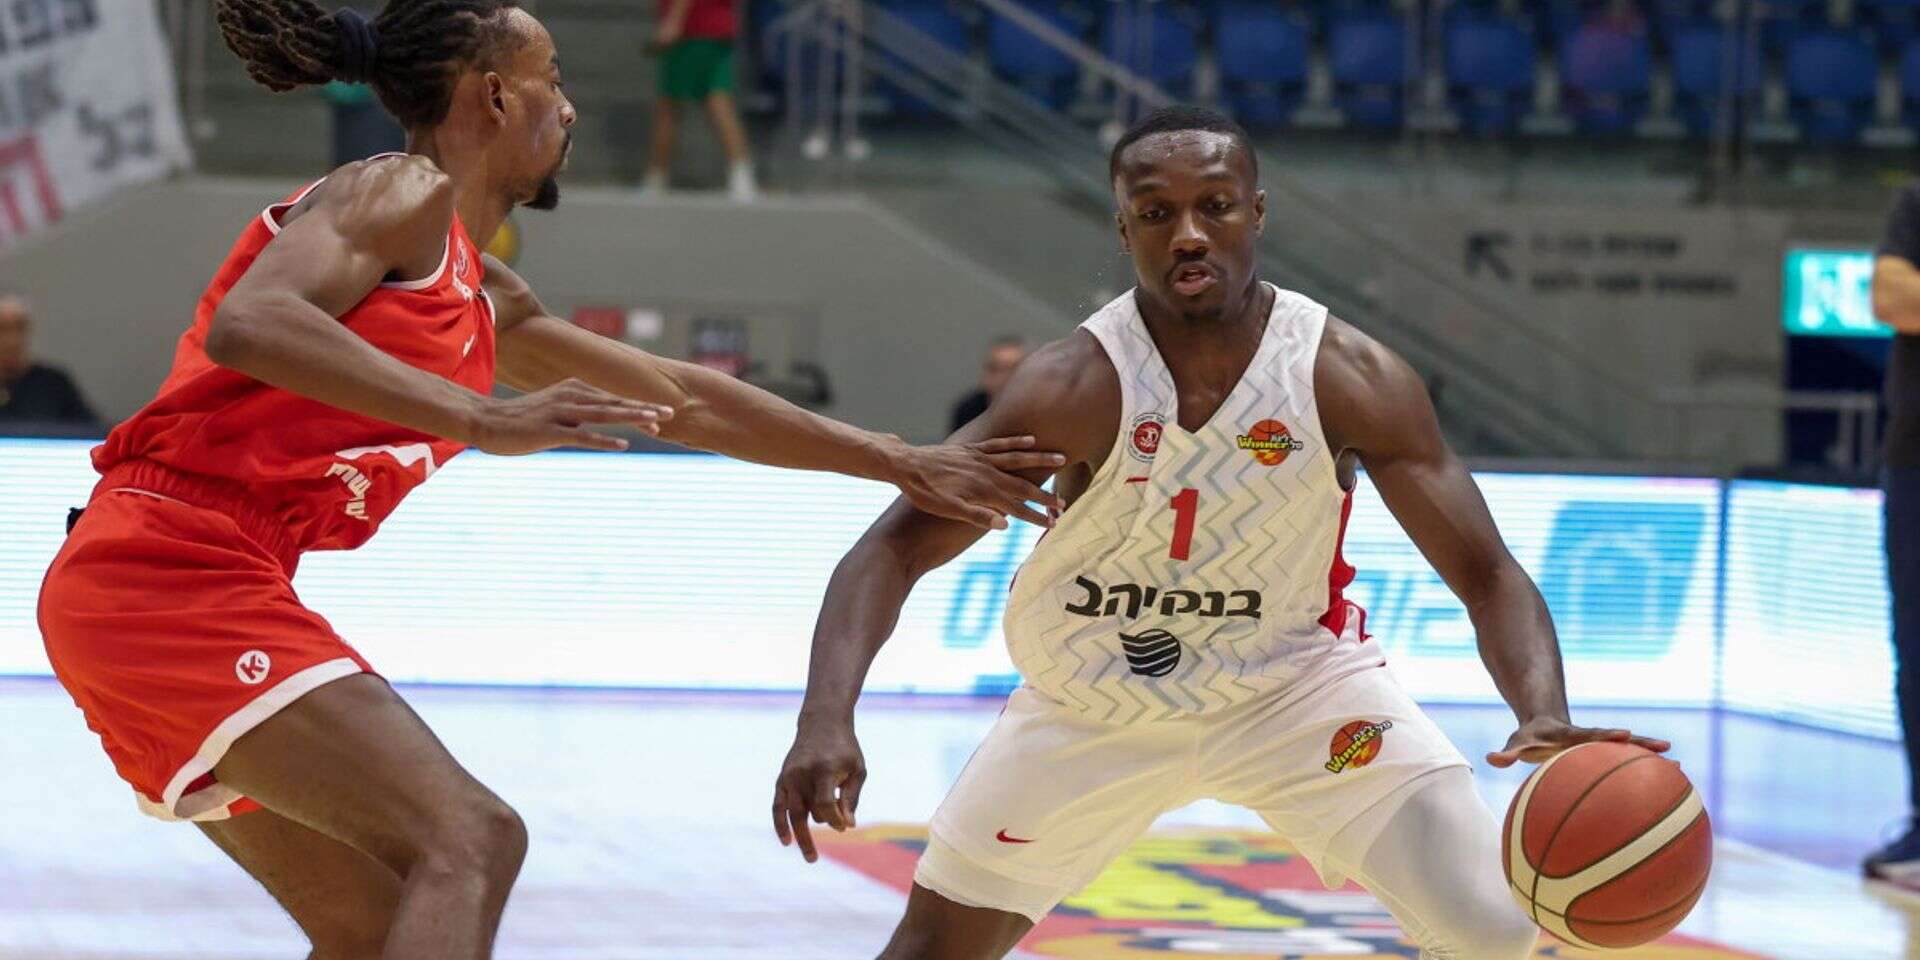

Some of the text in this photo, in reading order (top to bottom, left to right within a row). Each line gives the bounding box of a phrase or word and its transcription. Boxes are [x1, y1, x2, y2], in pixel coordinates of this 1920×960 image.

[1236, 434, 1290, 450] Winner
[1168, 487, 1200, 561] 1
[1325, 727, 1377, 774] Winner
